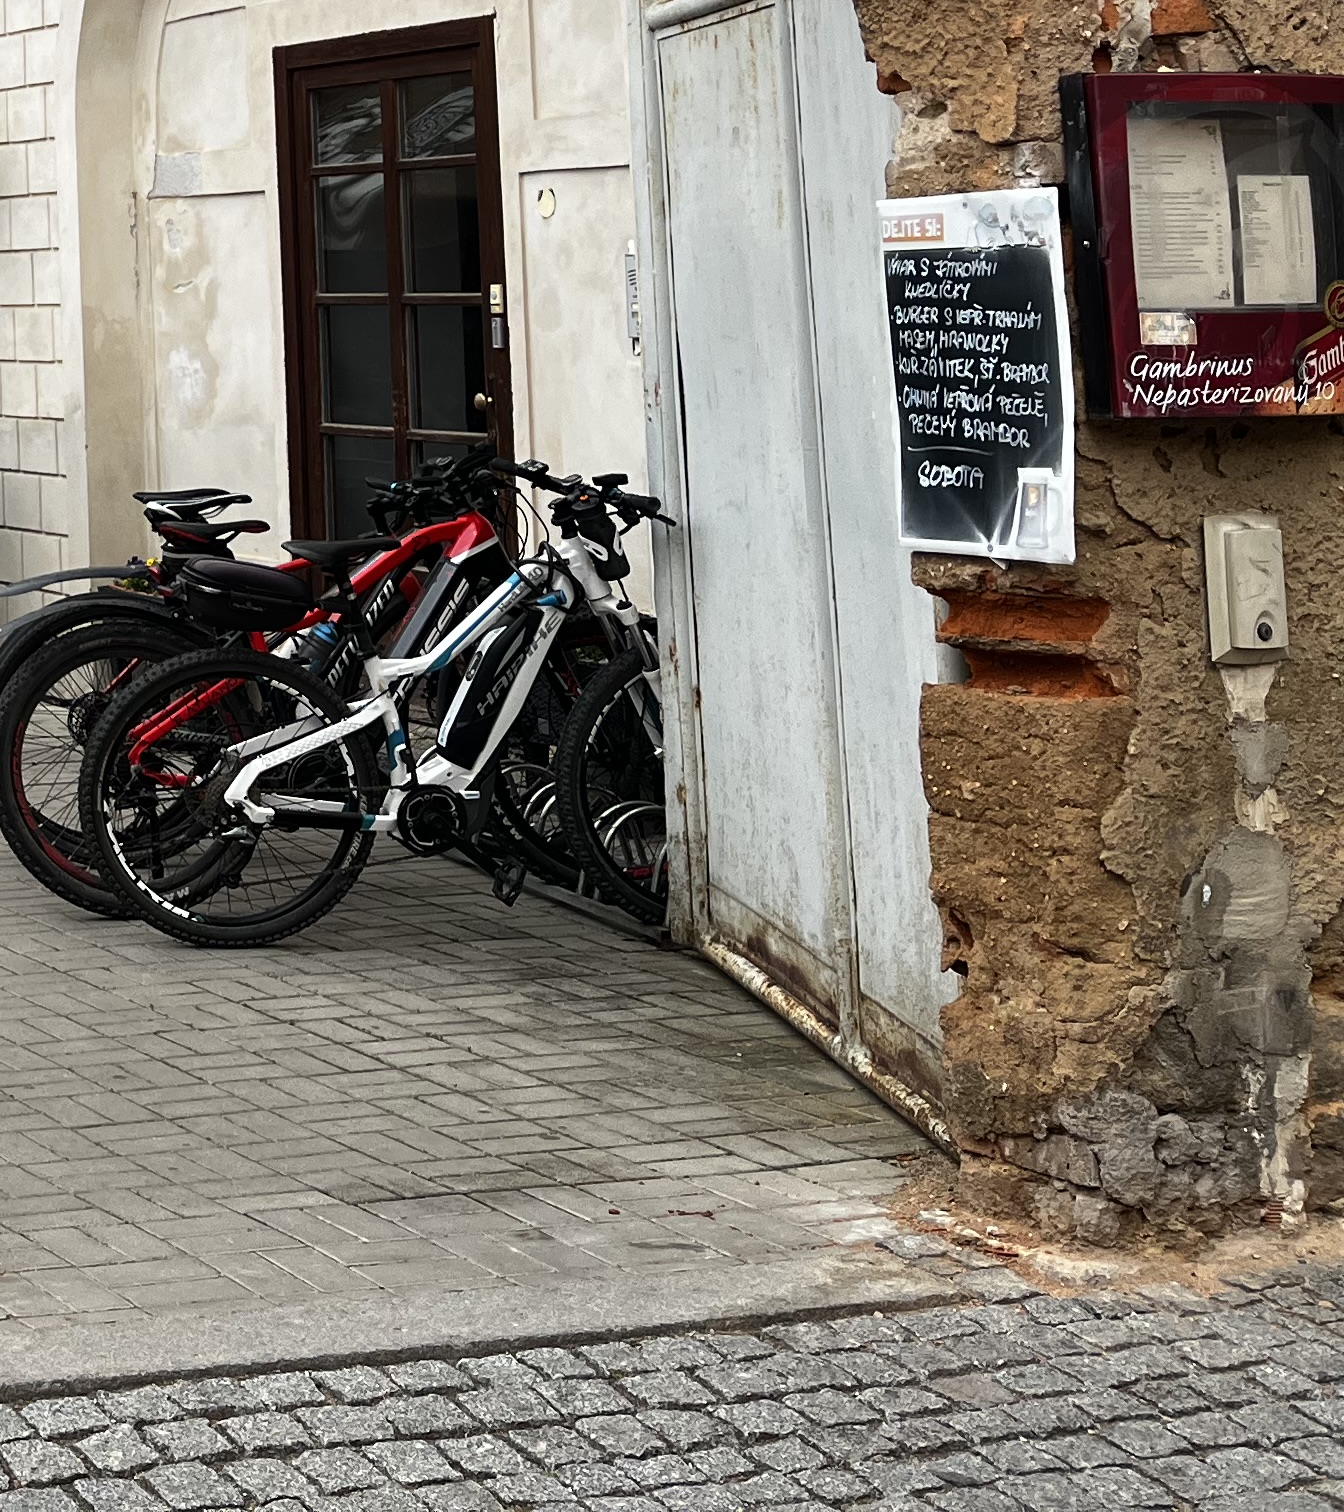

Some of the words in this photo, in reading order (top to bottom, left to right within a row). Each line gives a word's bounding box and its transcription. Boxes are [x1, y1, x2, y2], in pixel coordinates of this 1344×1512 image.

[882, 219, 921, 239] DEJTE
[920, 257, 930, 278] S
[943, 307, 953, 326] S
[1130, 350, 1254, 382] Gambrinus
[1313, 381, 1335, 401] 10
[918, 459, 986, 490] SOBOTA
